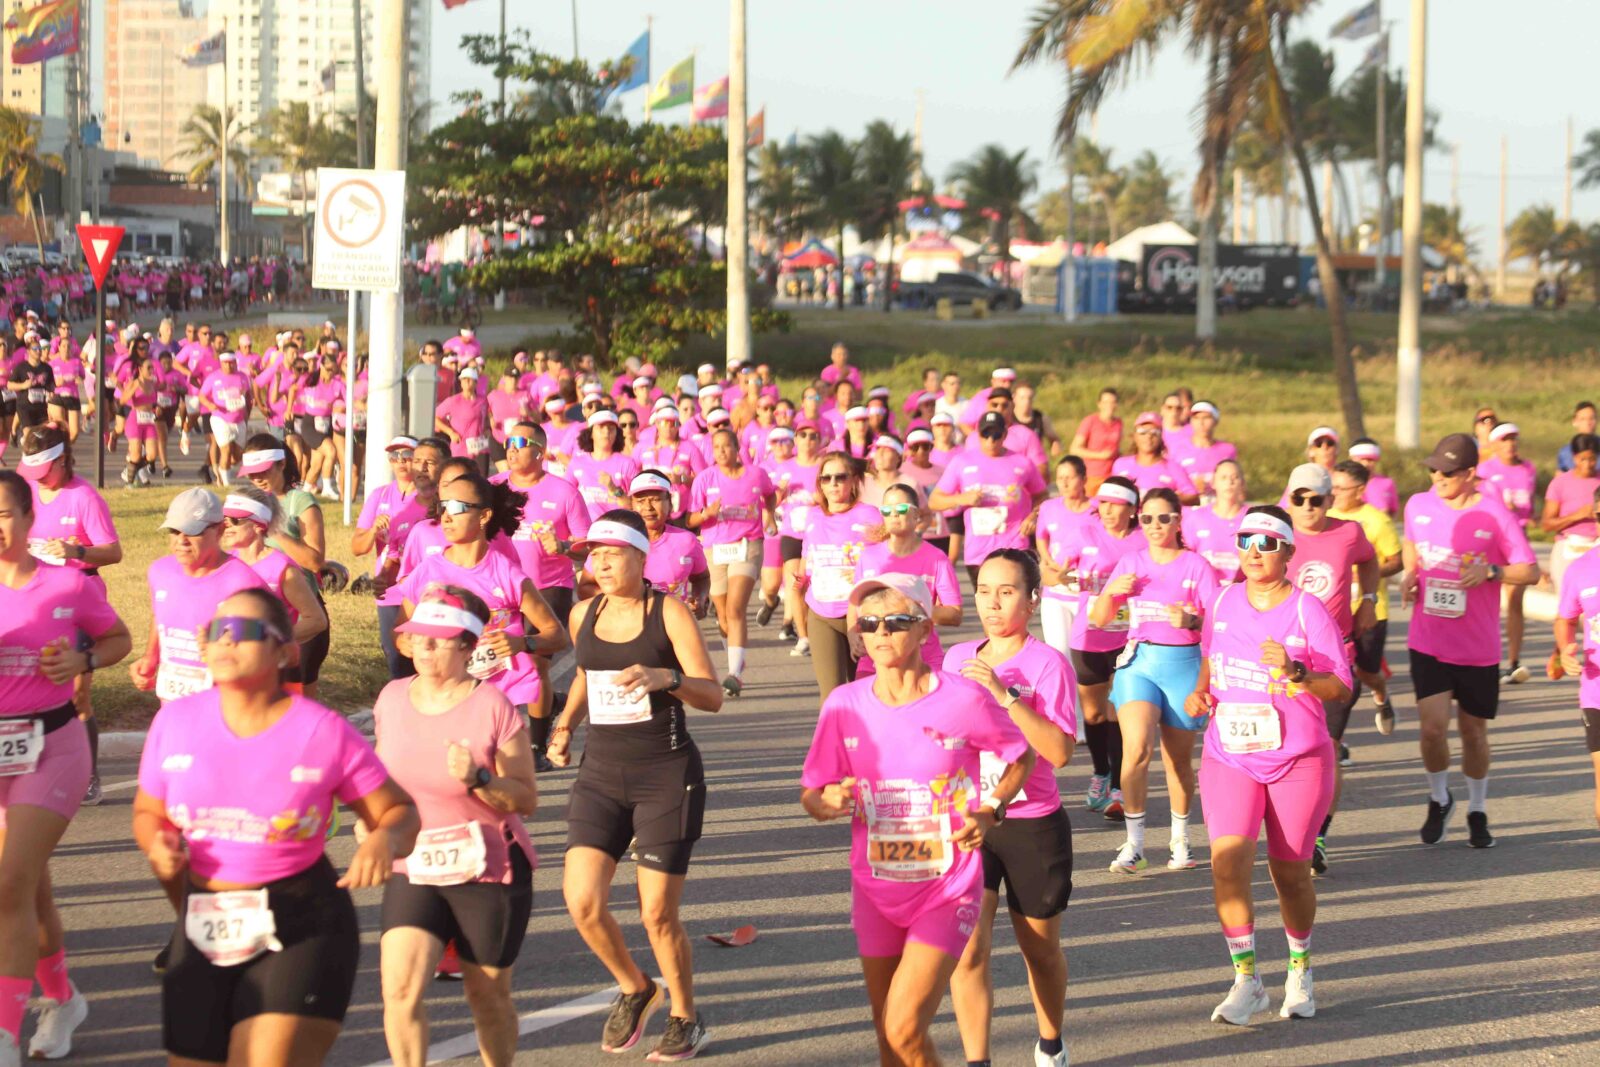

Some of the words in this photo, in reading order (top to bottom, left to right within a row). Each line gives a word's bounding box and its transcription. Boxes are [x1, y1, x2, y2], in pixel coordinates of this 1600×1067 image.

[1229, 721, 1258, 736] 321
[0, 738, 28, 757] 25
[878, 841, 932, 861] 1224
[203, 919, 243, 941] 287
